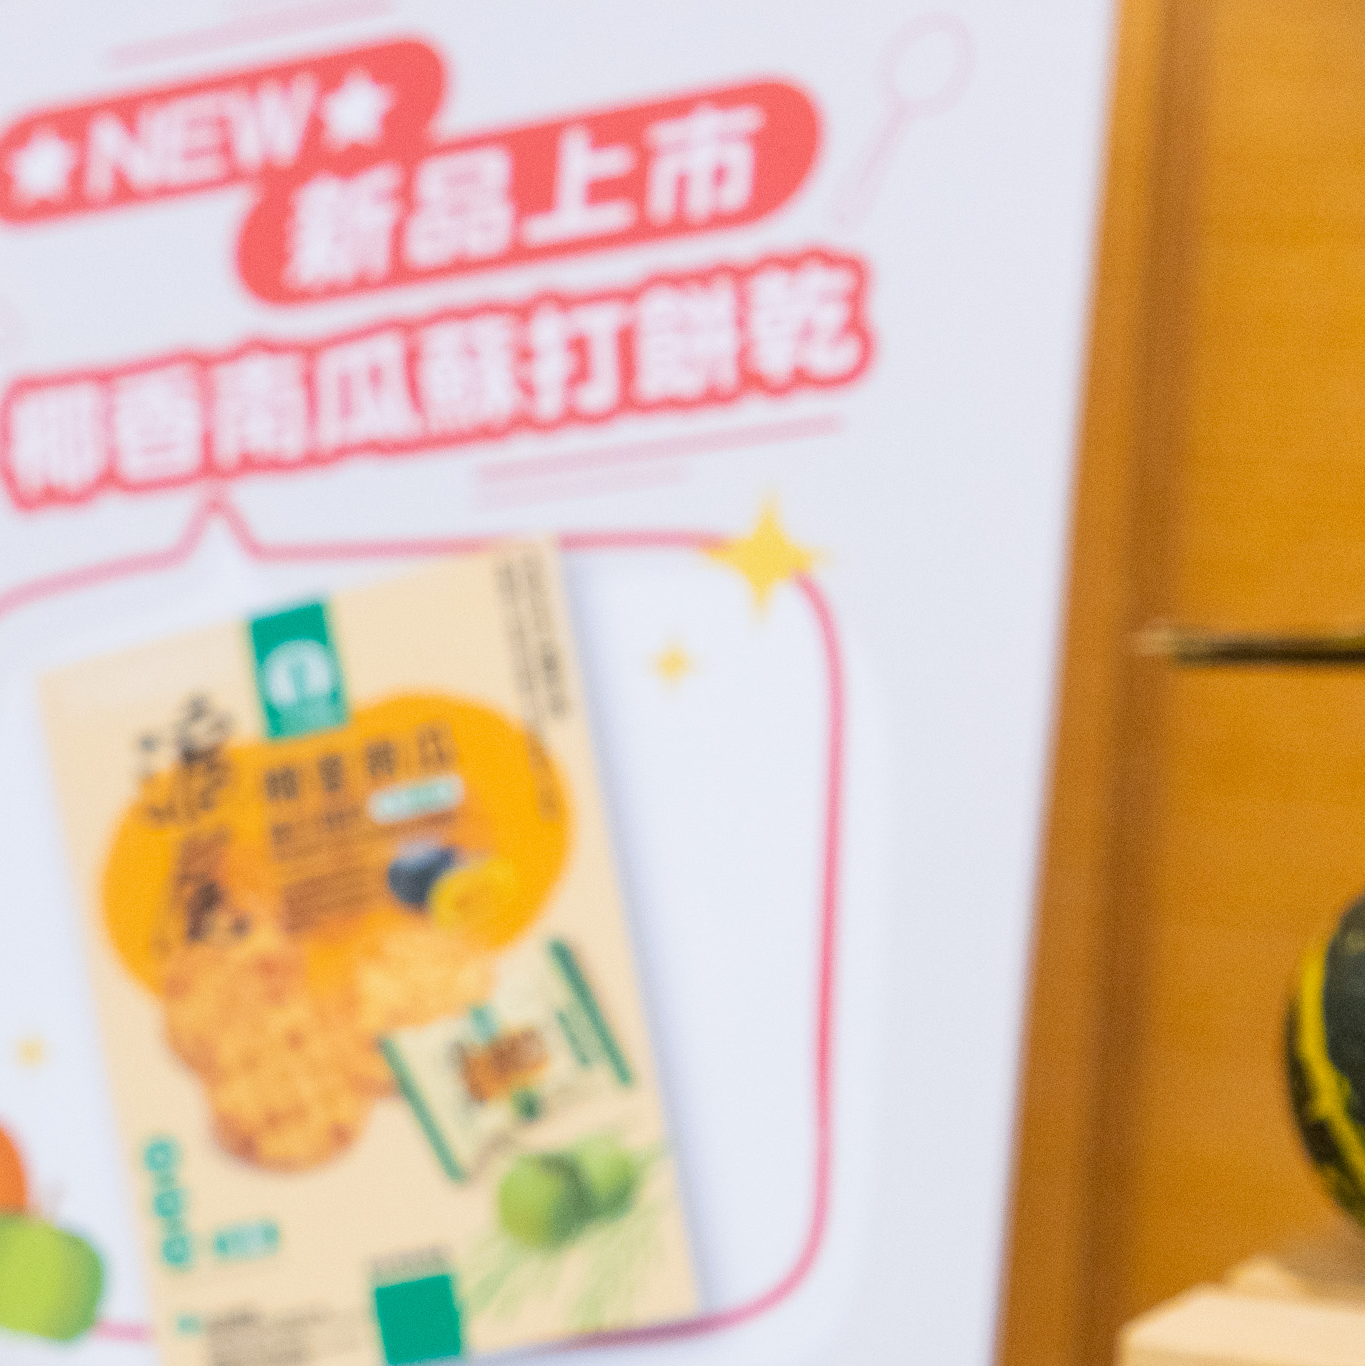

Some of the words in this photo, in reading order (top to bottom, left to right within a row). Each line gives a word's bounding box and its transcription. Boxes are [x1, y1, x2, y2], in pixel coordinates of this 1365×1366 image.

[82, 72, 320, 201] NEW
[279, 102, 767, 291] 新品上市
[3, 254, 868, 502] 椰香南瓜蘇打餅乾
